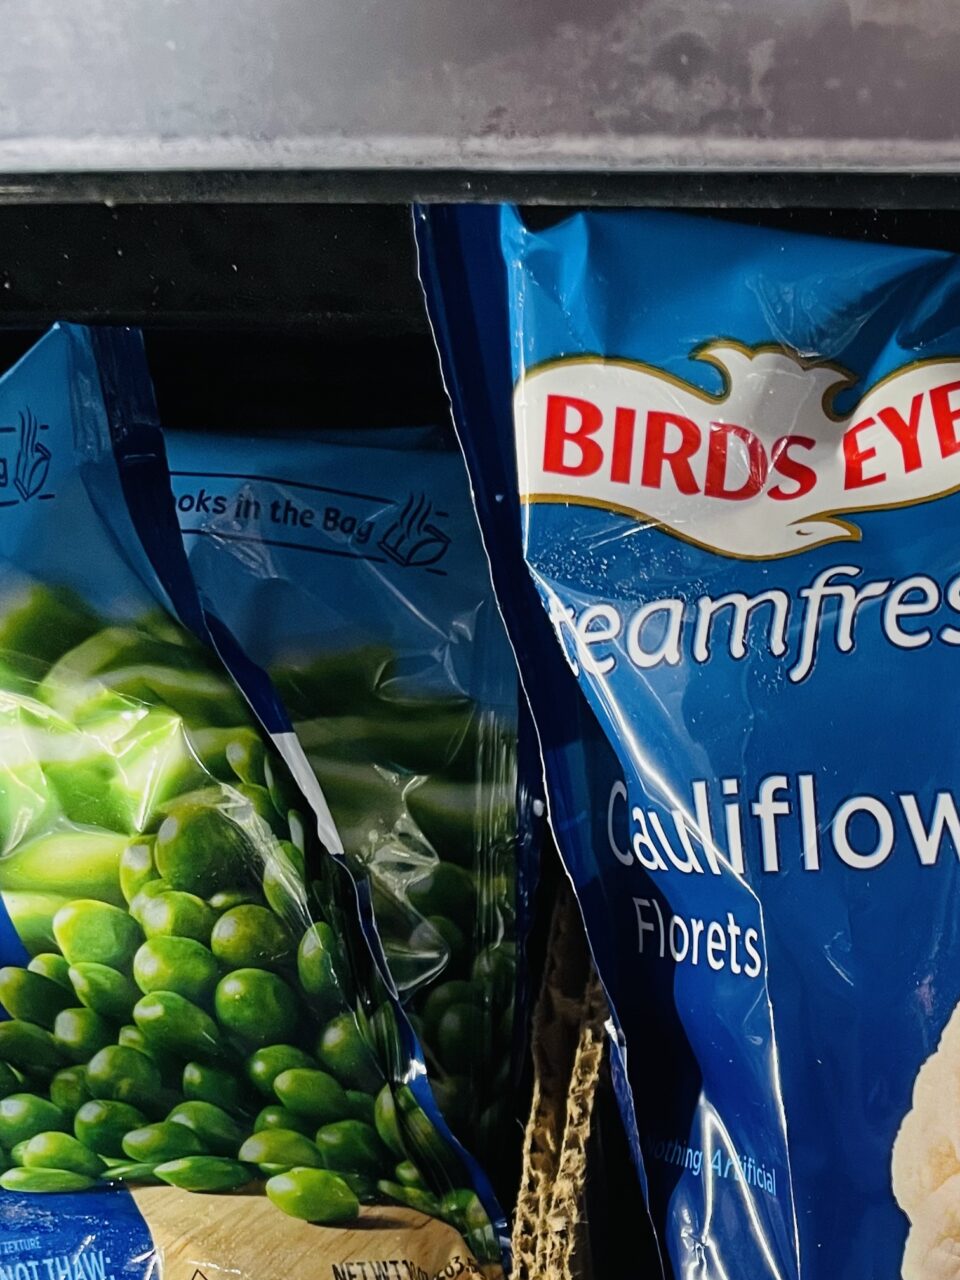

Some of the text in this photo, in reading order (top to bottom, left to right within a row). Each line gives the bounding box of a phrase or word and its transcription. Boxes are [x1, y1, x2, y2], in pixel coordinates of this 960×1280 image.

[541, 394, 817, 502] BIRDS
[176, 489, 376, 545] oks in the Bag
[632, 896, 763, 979] Florets
